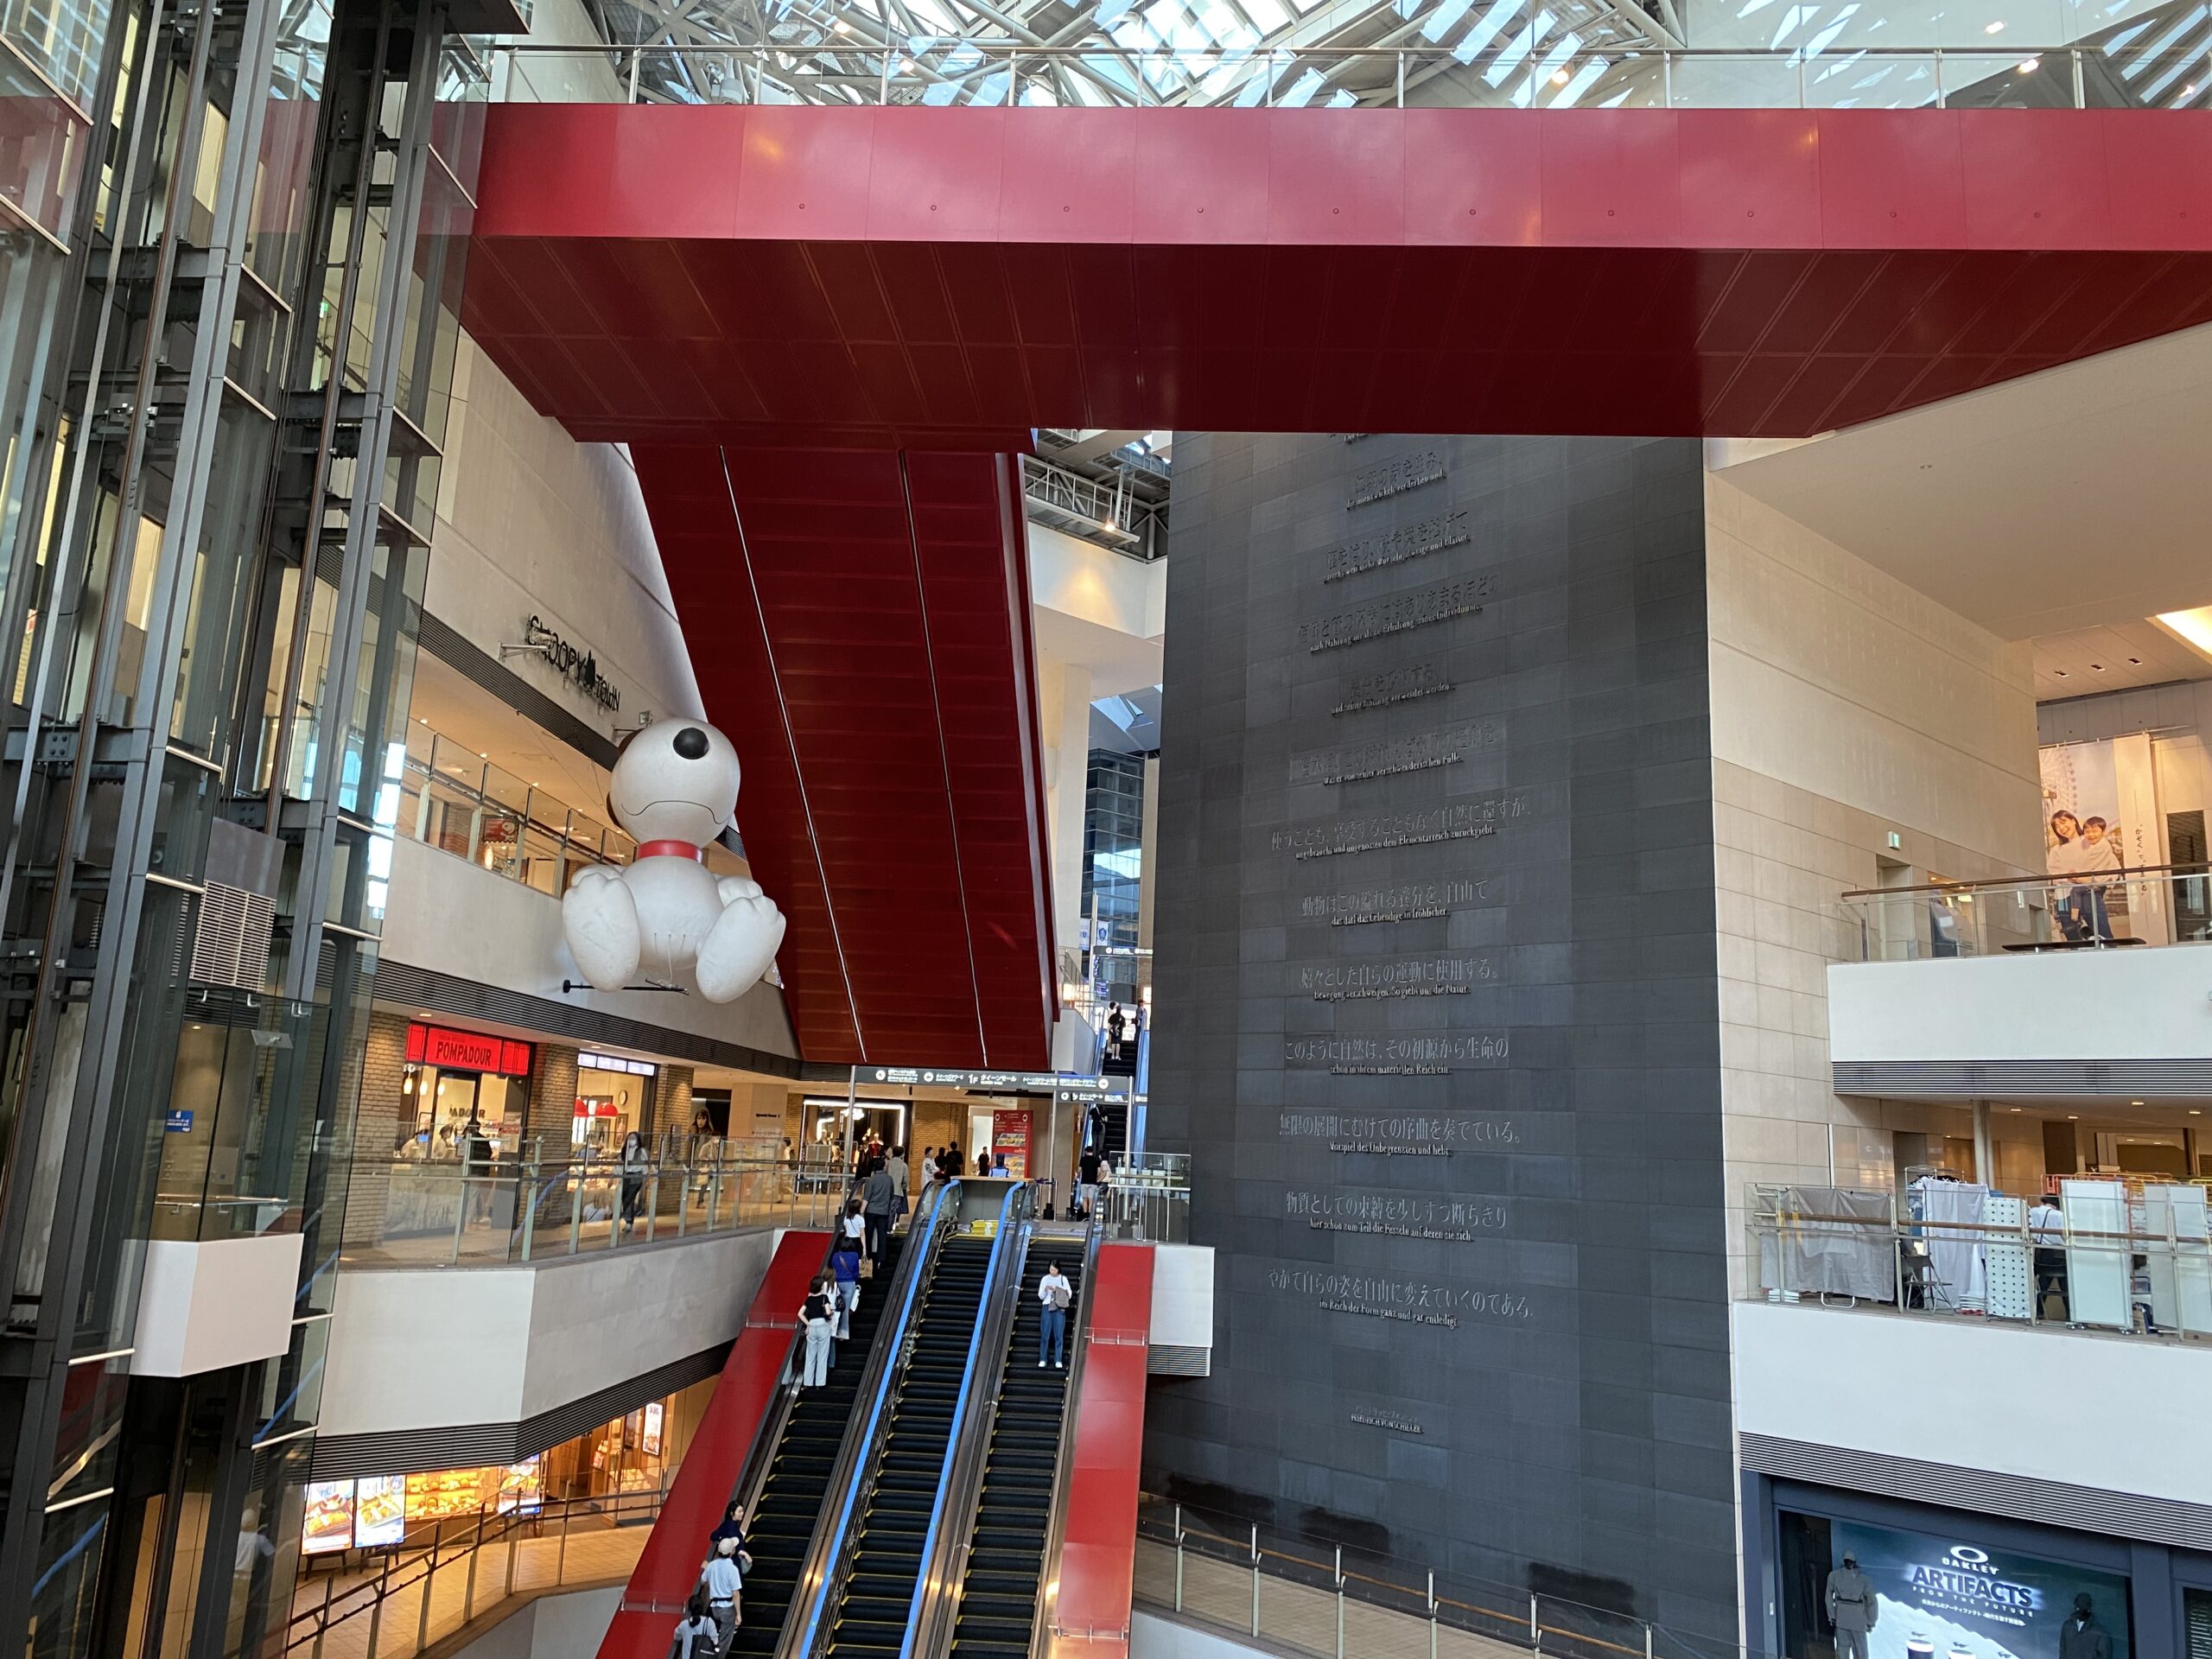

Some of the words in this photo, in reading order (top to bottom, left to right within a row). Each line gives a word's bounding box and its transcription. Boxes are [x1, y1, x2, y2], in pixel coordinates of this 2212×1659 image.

[435, 1040, 493, 1067] POMPADOUR
[1415, 1064, 1435, 1075] Reich
[1330, 1141, 1357, 1155] Vorspiel
[1417, 1144, 1432, 1156] und
[1323, 1219, 1343, 1231] schon
[1423, 1227, 1443, 1240] deren
[1329, 1299, 1347, 1312] Reich
[1361, 1303, 1379, 1316] Form
[1942, 1556, 1999, 1575] OAKLEY
[1912, 1566, 2033, 1608] ARTIFACTS
[1912, 1586, 1944, 1598] FROM
[1953, 1594, 1975, 1605] THE
[1985, 1601, 2034, 1618] FUTURE
